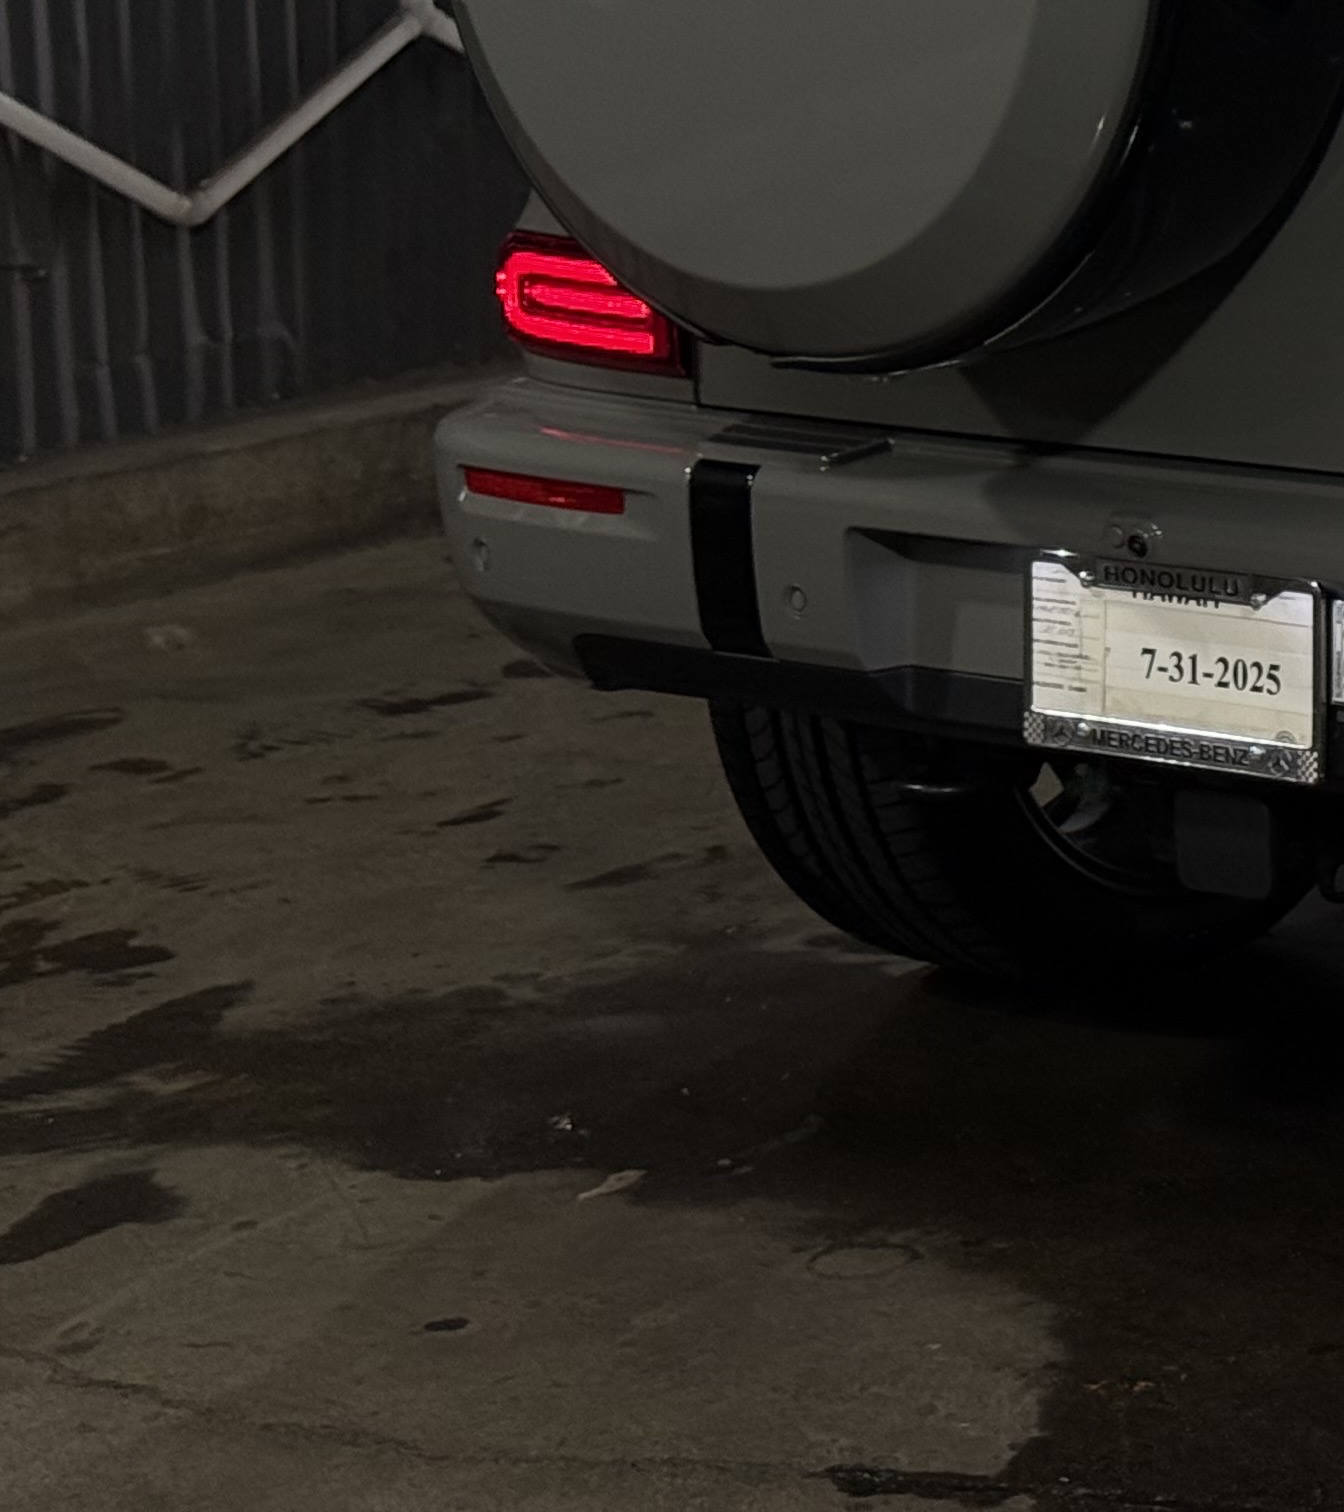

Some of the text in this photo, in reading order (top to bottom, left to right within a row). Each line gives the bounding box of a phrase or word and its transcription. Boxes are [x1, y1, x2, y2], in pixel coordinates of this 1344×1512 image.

[1103, 565, 1239, 598] HONOLULU
[1140, 648, 1282, 695] 7-31-2025
[1090, 729, 1249, 766] MERCEDES-BENZ
